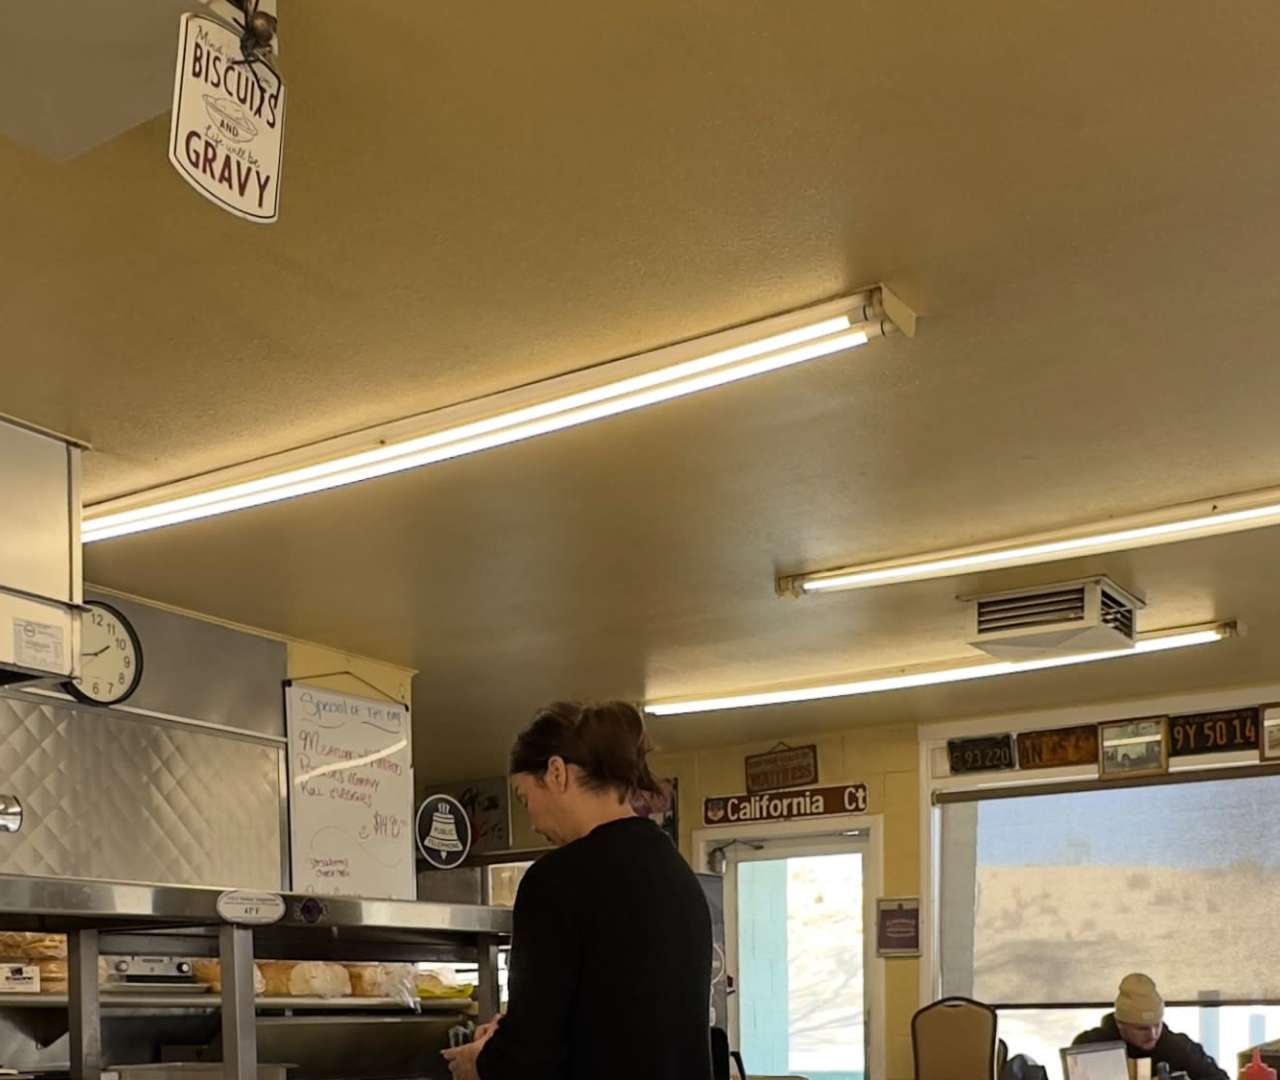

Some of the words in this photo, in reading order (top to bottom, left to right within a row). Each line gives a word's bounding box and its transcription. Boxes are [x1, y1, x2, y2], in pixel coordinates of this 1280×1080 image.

[192, 42, 278, 129] BISCUITS
[220, 119, 239, 138] AND
[185, 130, 271, 208] GRAVY
[91, 613, 104, 627] 12
[106, 622, 117, 636] 11
[116, 639, 127, 651] 10
[123, 656, 131, 668] 9
[118, 673, 126, 685] 8
[92, 682, 100, 695] 6
[107, 682, 114, 695] 7
[1172, 724, 1198, 750] 9Y
[1232, 717, 1256, 745] 14
[727, 790, 825, 822] California
[843, 786, 866, 811] Ct
